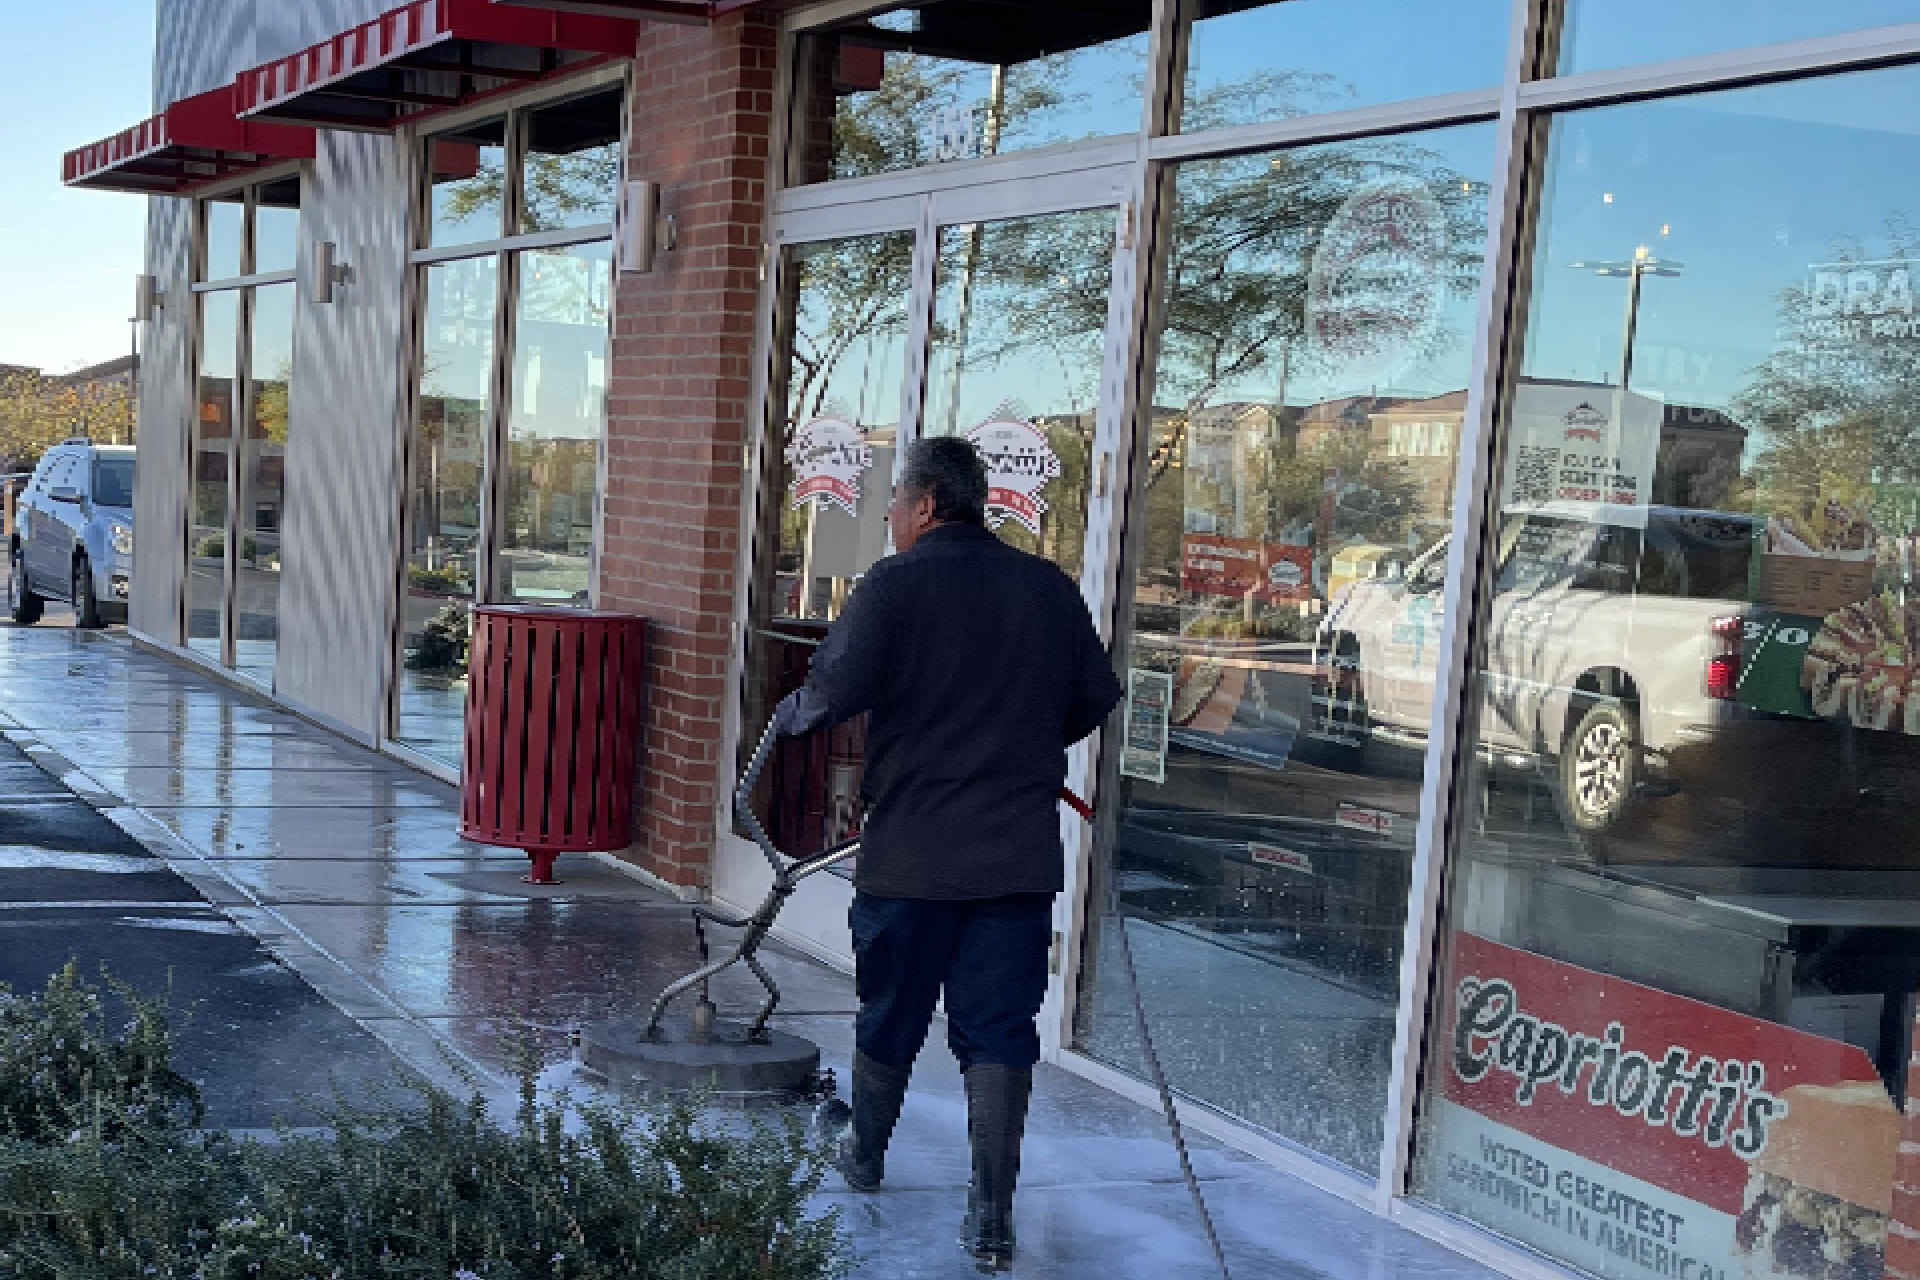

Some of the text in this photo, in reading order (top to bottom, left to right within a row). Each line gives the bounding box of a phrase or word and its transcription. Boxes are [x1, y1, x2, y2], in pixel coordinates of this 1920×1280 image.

[1453, 975, 1785, 1158] Capriotti's
[1479, 1133, 1685, 1245] VOTED GREATEST
[1567, 1206, 1589, 1241] IN
